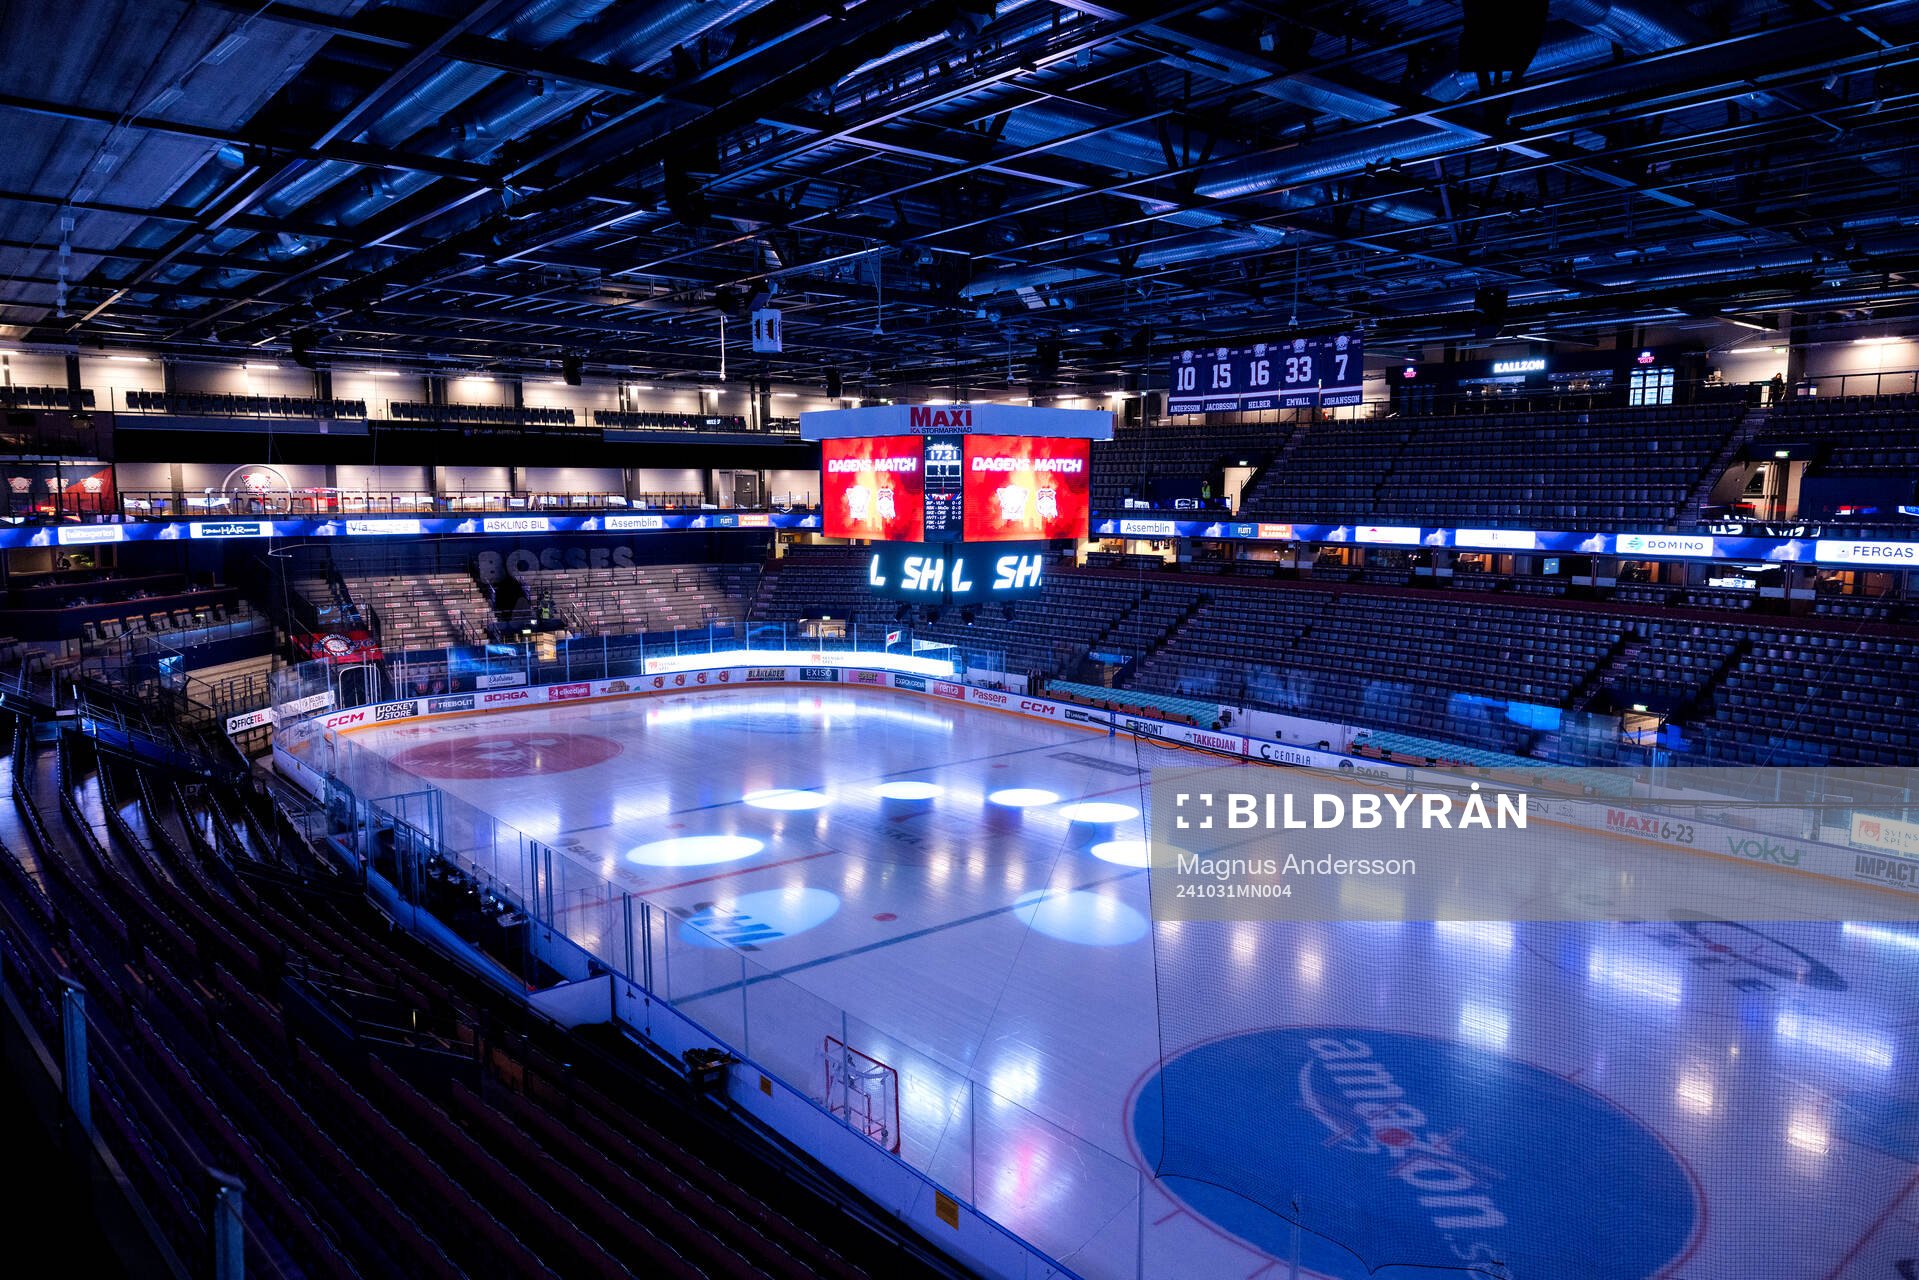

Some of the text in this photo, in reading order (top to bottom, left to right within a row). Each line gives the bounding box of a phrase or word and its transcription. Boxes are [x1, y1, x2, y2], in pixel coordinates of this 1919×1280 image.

[1249, 360, 1270, 387] 16
[1285, 357, 1313, 384] 33
[1334, 354, 1349, 382] 7
[1494, 359, 1545, 373] KALLZON
[1176, 367, 1196, 391] 10
[1211, 363, 1232, 389] 15
[1204, 402, 1238, 411] JACOBSSON
[1322, 395, 1361, 406] JOHANSSON
[910, 406, 972, 428] MAXI
[1169, 404, 1201, 414] ANDERSSON
[921, 426, 972, 434] STORMARKNAD
[828, 457, 917, 473] DAGENS MATCH
[972, 456, 1083, 473] DAGENS MATCH
[611, 517, 658, 529] Assemblin
[1125, 522, 1170, 534] Assemblin
[1647, 540, 1704, 552] DOMINO
[1853, 545, 1915, 559] FERGAS
[939, 683, 959, 696] renta
[973, 687, 1007, 704] Passera
[377, 701, 416, 718] HOCKEY
[384, 709, 411, 720] STORE
[1020, 700, 1056, 715] CCM
[231, 713, 265, 731] OFFICETEL
[326, 711, 365, 729] CCM
[1138, 721, 1164, 736] FRONT
[1193, 732, 1237, 751] TAKKEDJAN
[1606, 807, 1660, 835] MAXI
[1855, 855, 1919, 884] IMPACT
